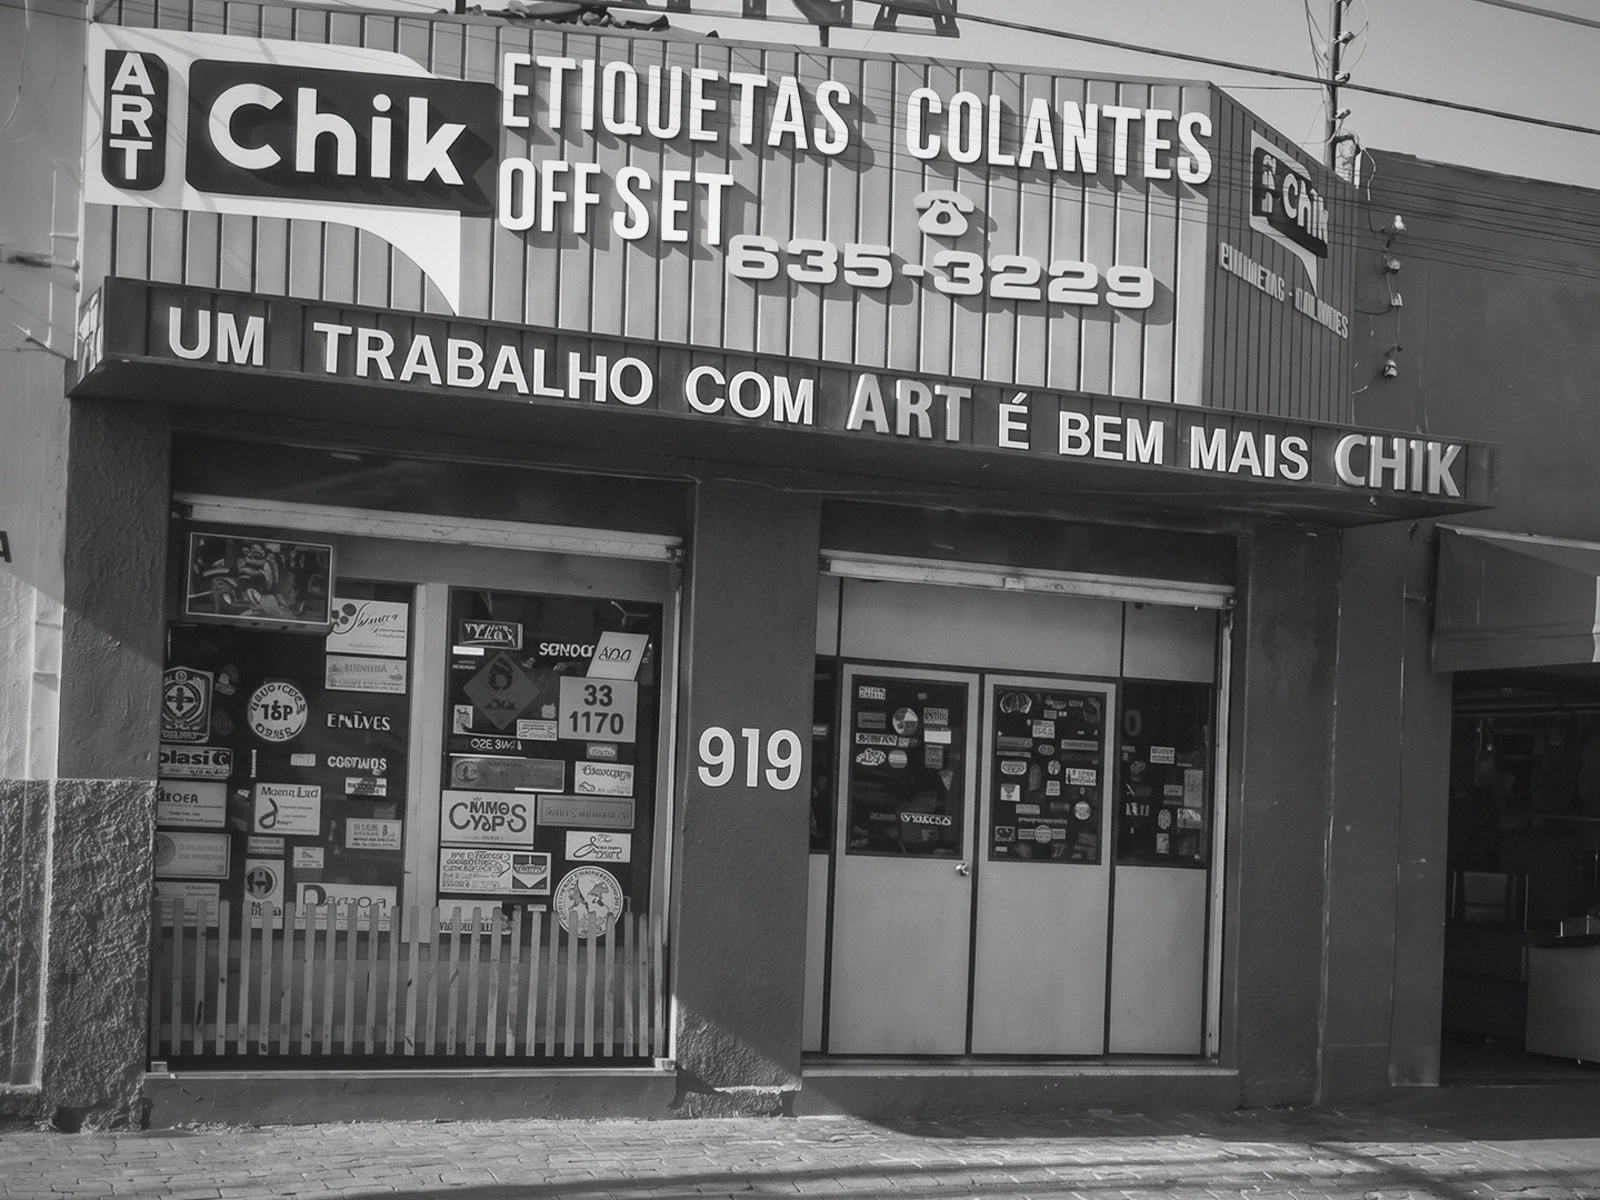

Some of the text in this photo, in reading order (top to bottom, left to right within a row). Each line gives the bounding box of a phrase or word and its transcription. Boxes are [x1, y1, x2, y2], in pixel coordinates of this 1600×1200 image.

[110, 51, 468, 187] ART Chik
[502, 52, 851, 156] ETIQUETAS
[906, 87, 1213, 185] COLANTES
[727, 234, 1155, 310] 635-3229
[168, 306, 1462, 498] UM TRABALHO COM ART É BEM MAIS CHIK
[569, 711, 624, 736] 1170
[583, 684, 613, 707] 33
[697, 726, 802, 791] 919
